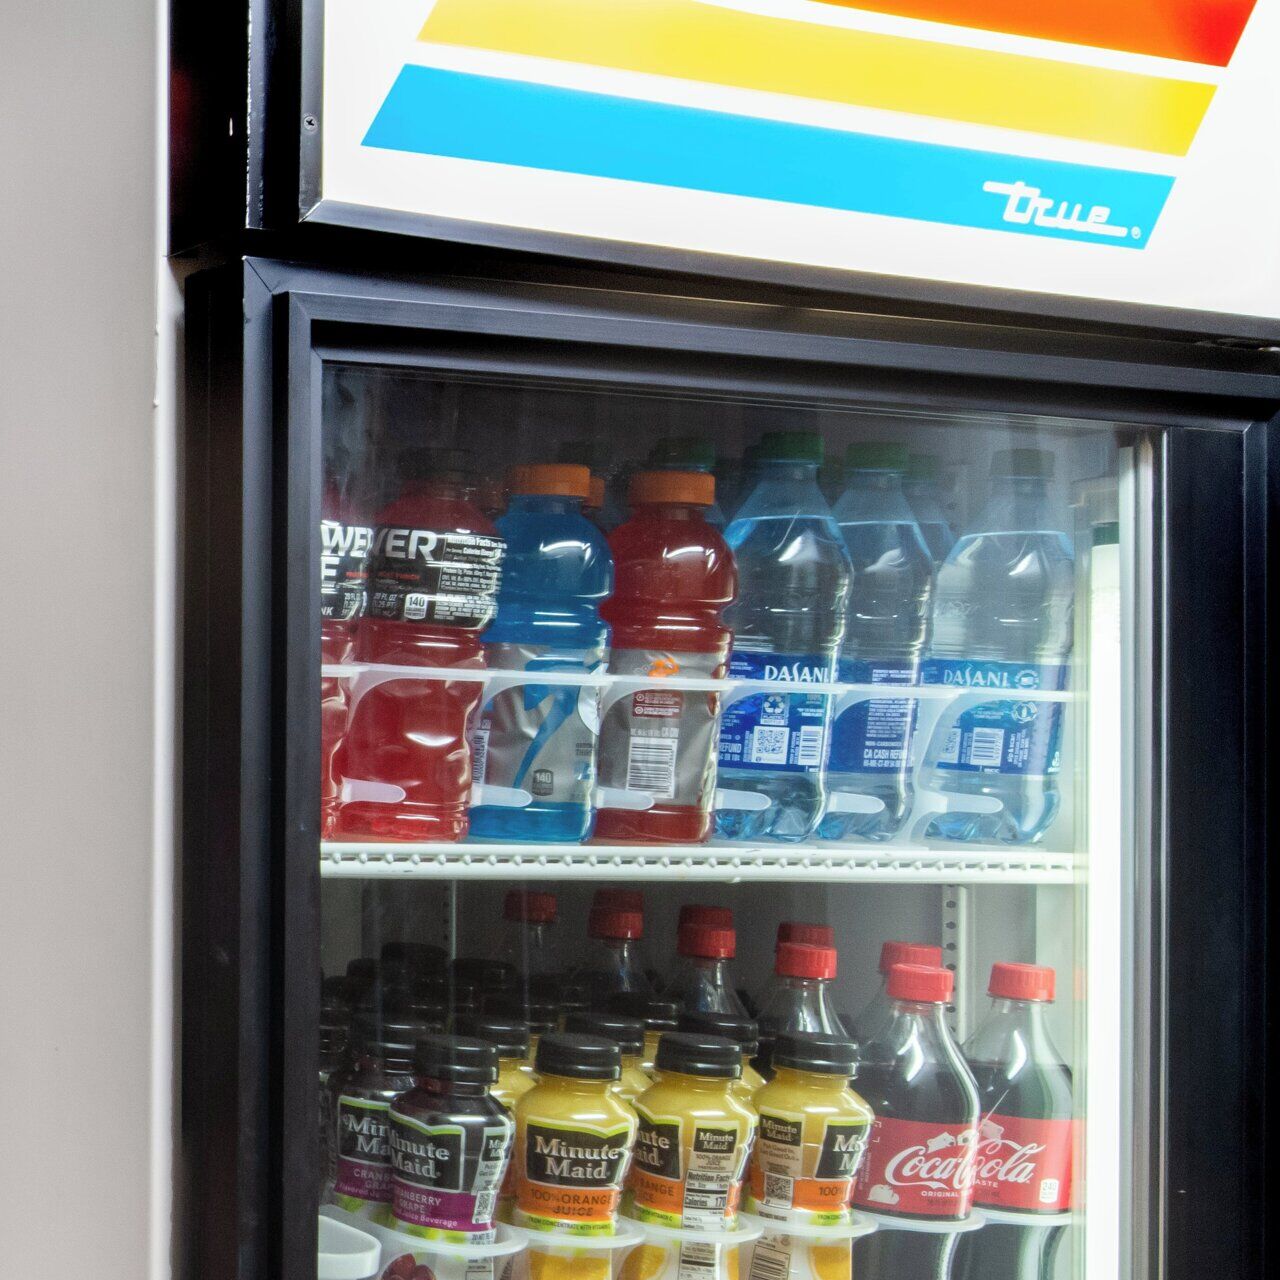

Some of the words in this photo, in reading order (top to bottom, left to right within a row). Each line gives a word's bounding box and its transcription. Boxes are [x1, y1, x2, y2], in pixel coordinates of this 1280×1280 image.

[983, 181, 1129, 237] true
[407, 595, 425, 608] 140
[764, 662, 829, 683] DASANI
[943, 663, 1010, 688] DASANI
[763, 1119, 798, 1134] Minute
[698, 1132, 734, 1143] Minute
[703, 1139, 728, 1151] Maid
[534, 1135, 620, 1161] Minute
[545, 1156, 608, 1181] Maid
[921, 1189, 960, 1199] ORIGINAL
[551, 1205, 595, 1218] JUICE
[420, 1214, 459, 1229] Beverage
